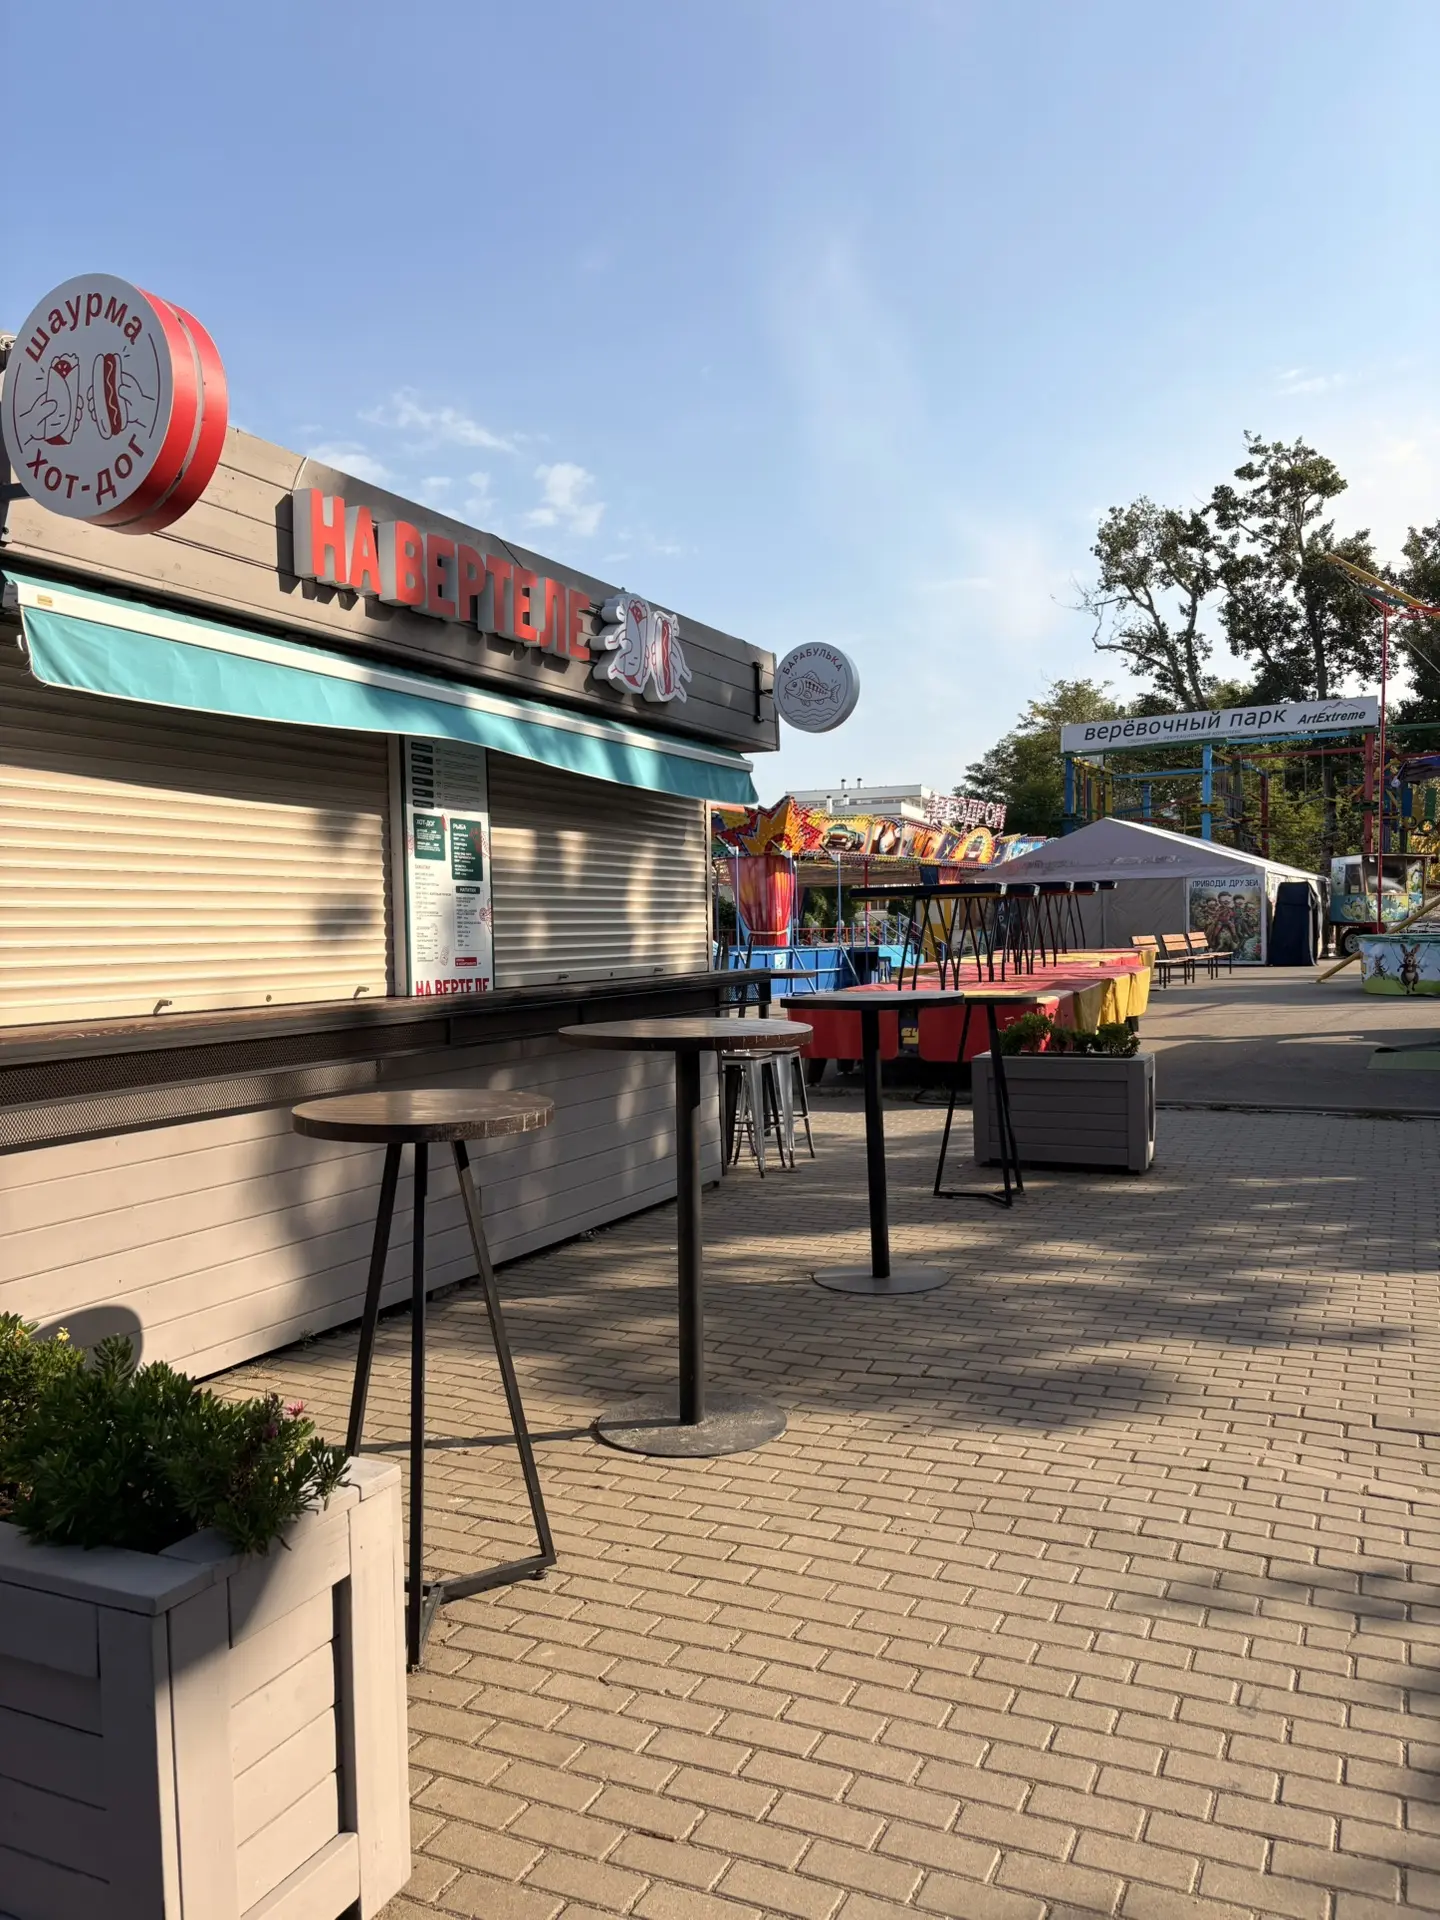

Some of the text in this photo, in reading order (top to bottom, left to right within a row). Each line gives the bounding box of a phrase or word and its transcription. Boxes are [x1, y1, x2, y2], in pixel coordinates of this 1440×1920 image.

[25, 292, 143, 363] шаурма
[26, 434, 145, 505] хот-дог
[311, 488, 591, 661] НА ВЕРТЕЛЕ
[782, 647, 843, 676] БАРАБУЛЬКА
[1084, 707, 1288, 743] верёвочный парк
[1297, 709, 1367, 725] ArtExtreme
[1192, 879, 1226, 888] ПРИВОДИ
